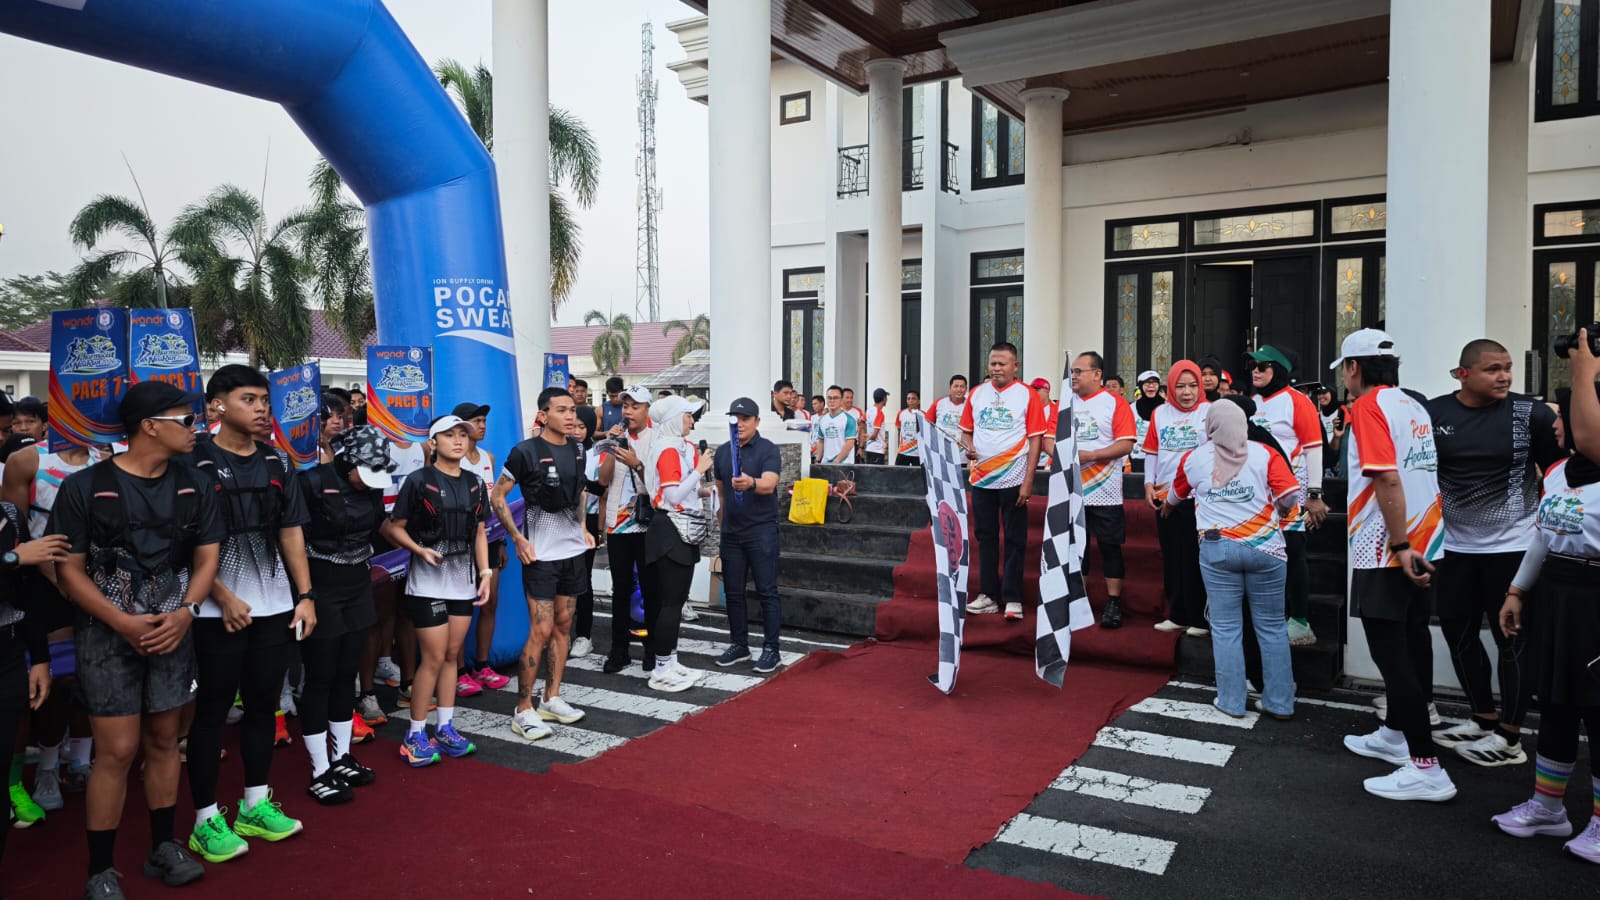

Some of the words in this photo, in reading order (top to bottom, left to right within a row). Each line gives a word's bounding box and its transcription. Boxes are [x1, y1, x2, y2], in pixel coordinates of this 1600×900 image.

[436, 307, 512, 328] SWEA
[72, 379, 107, 400] PACE
[113, 377, 122, 396] 7
[188, 371, 197, 389] 7
[387, 395, 417, 408] PACE
[421, 395, 430, 408] 6
[290, 420, 309, 440] PACE
[312, 416, 316, 431] 7
[1410, 419, 1429, 439] Run
[1421, 436, 1432, 448] For
[1206, 486, 1254, 502] Apothecary
